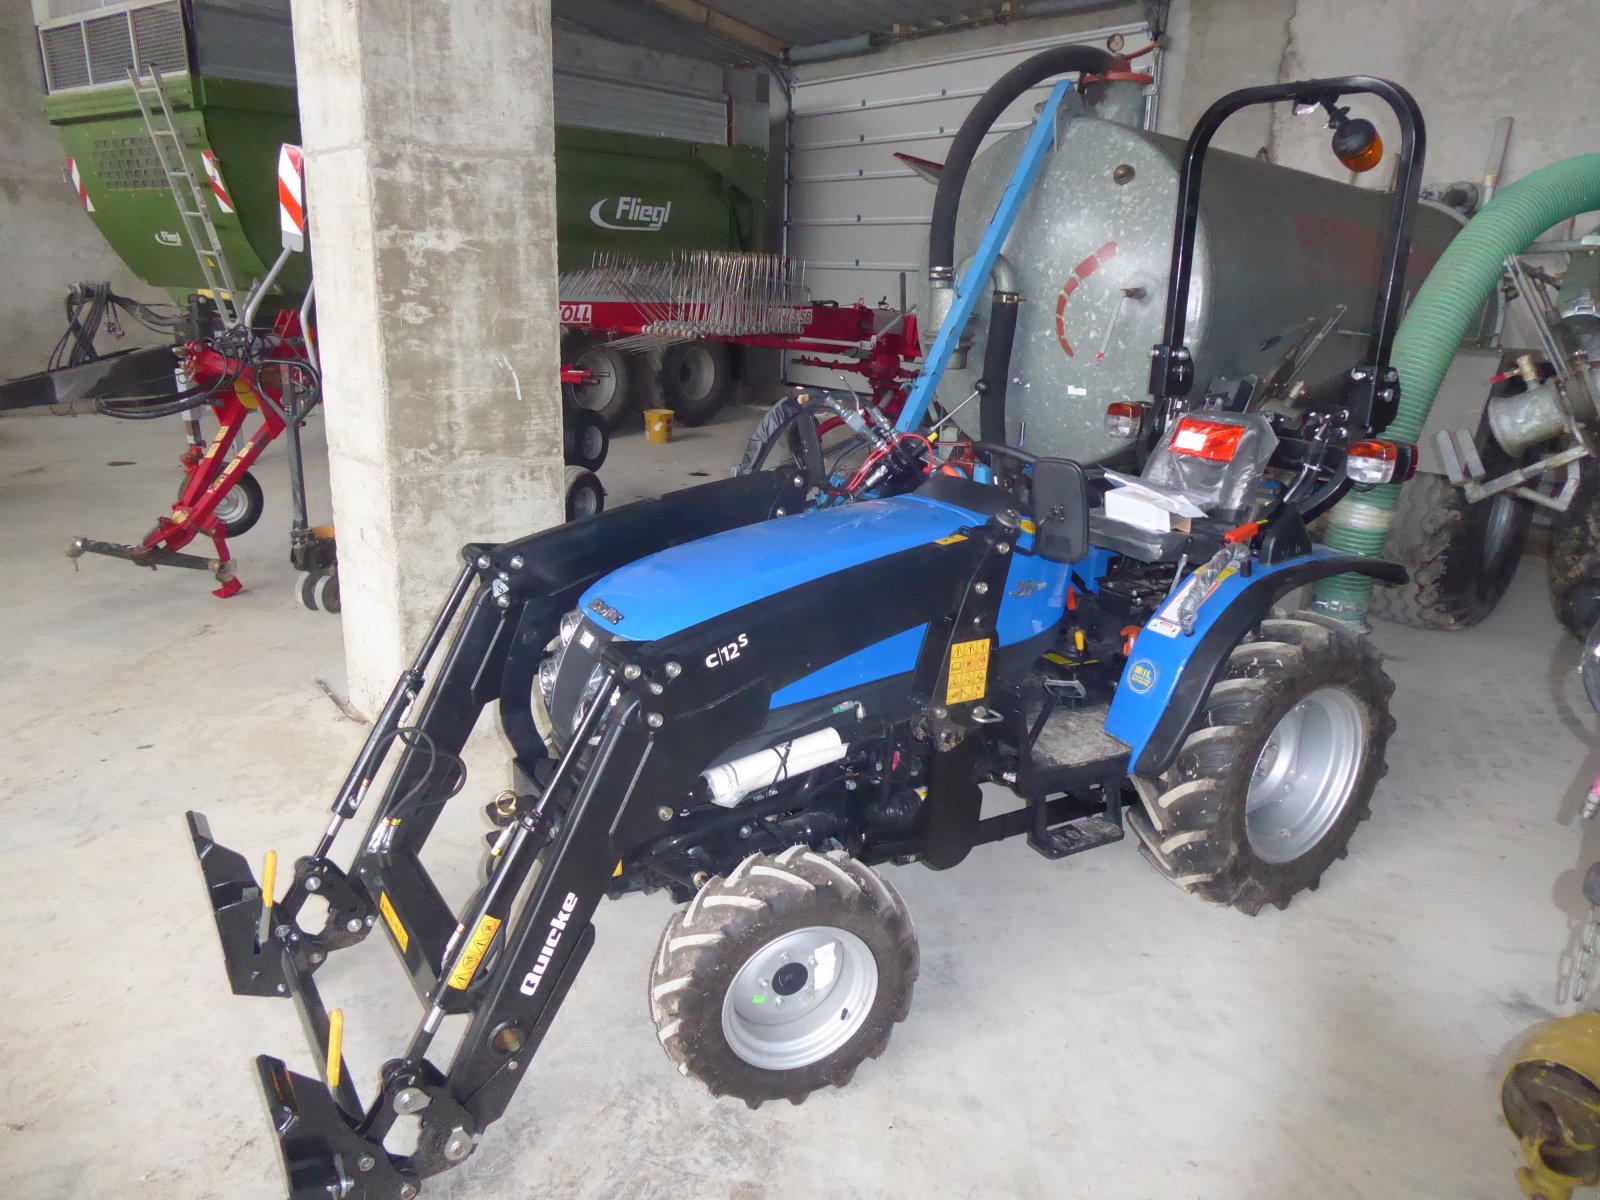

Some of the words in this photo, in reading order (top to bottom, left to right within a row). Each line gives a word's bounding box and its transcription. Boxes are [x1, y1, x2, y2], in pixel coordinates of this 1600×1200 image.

[615, 196, 671, 227] Fliegl
[559, 305, 591, 322] OLL
[519, 891, 578, 996] Quicke
